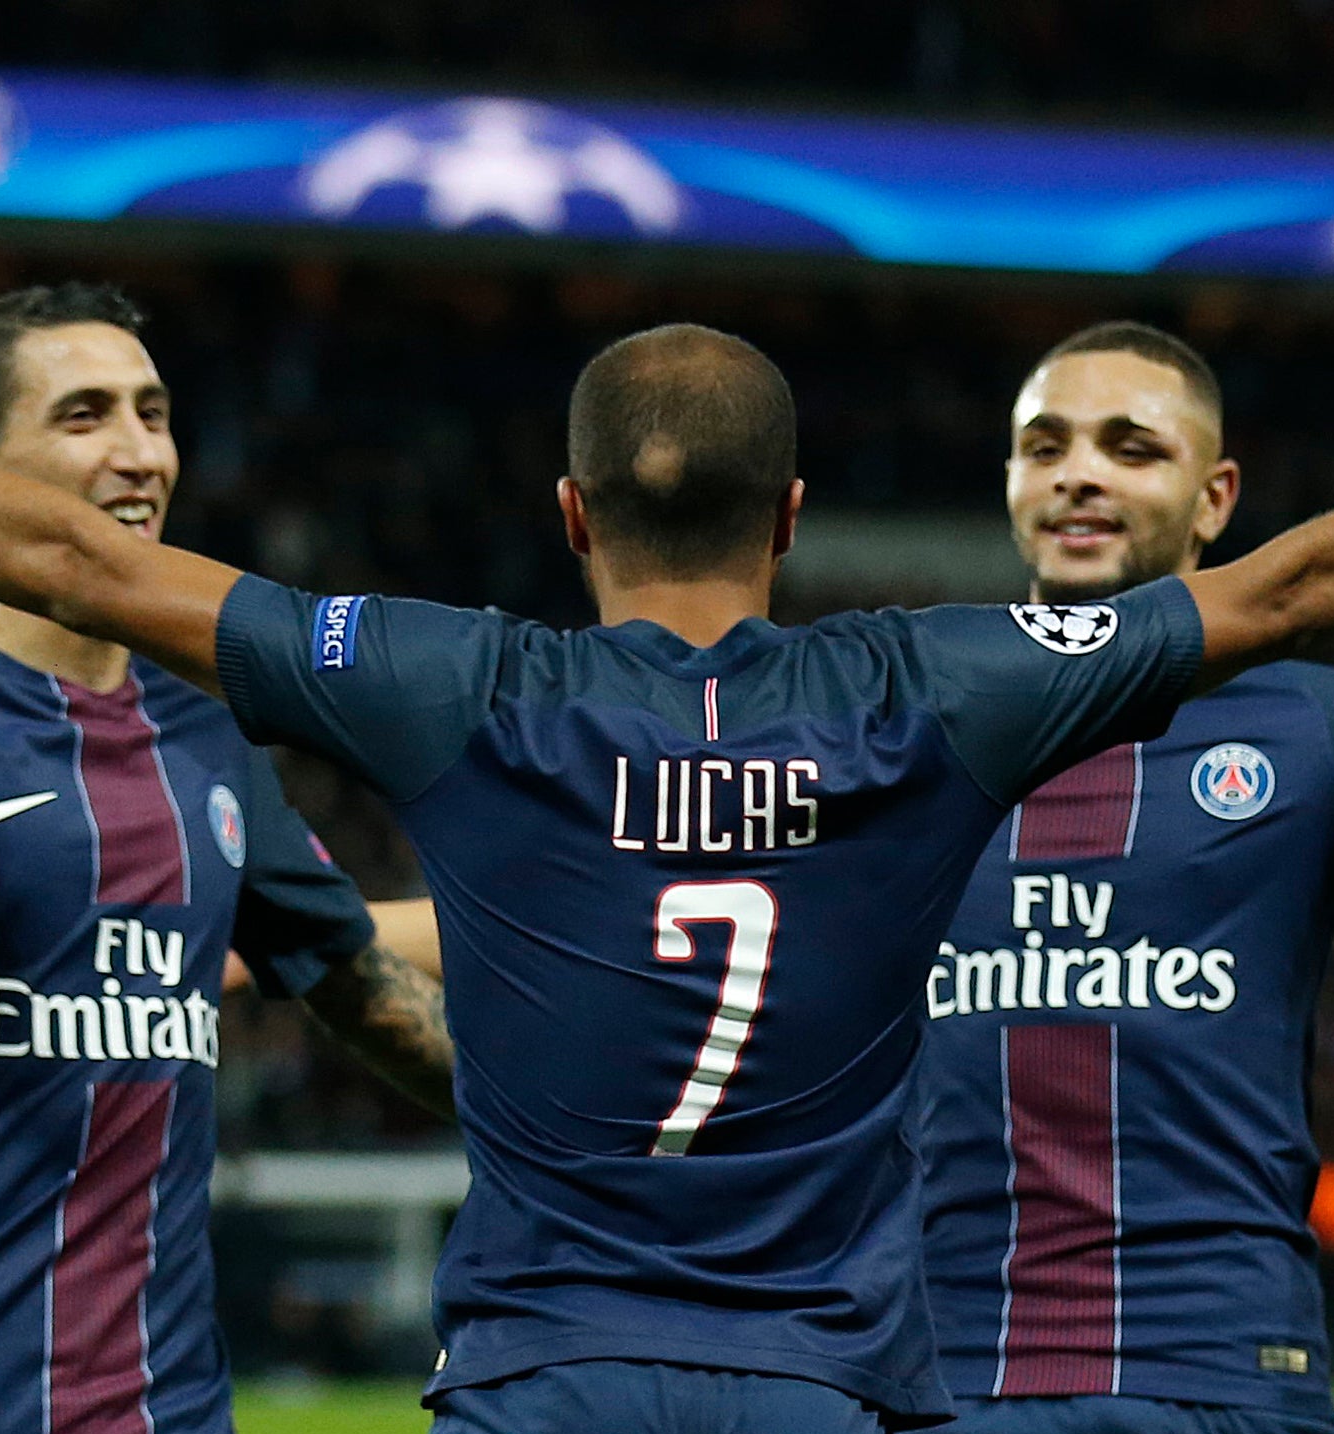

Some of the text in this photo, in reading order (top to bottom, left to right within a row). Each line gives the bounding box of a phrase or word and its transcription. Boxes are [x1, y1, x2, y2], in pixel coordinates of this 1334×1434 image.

[611, 755, 820, 853] LUCAS
[1013, 873, 1114, 938] Fly
[94, 918, 184, 986] Fly
[650, 878, 778, 1158] 7
